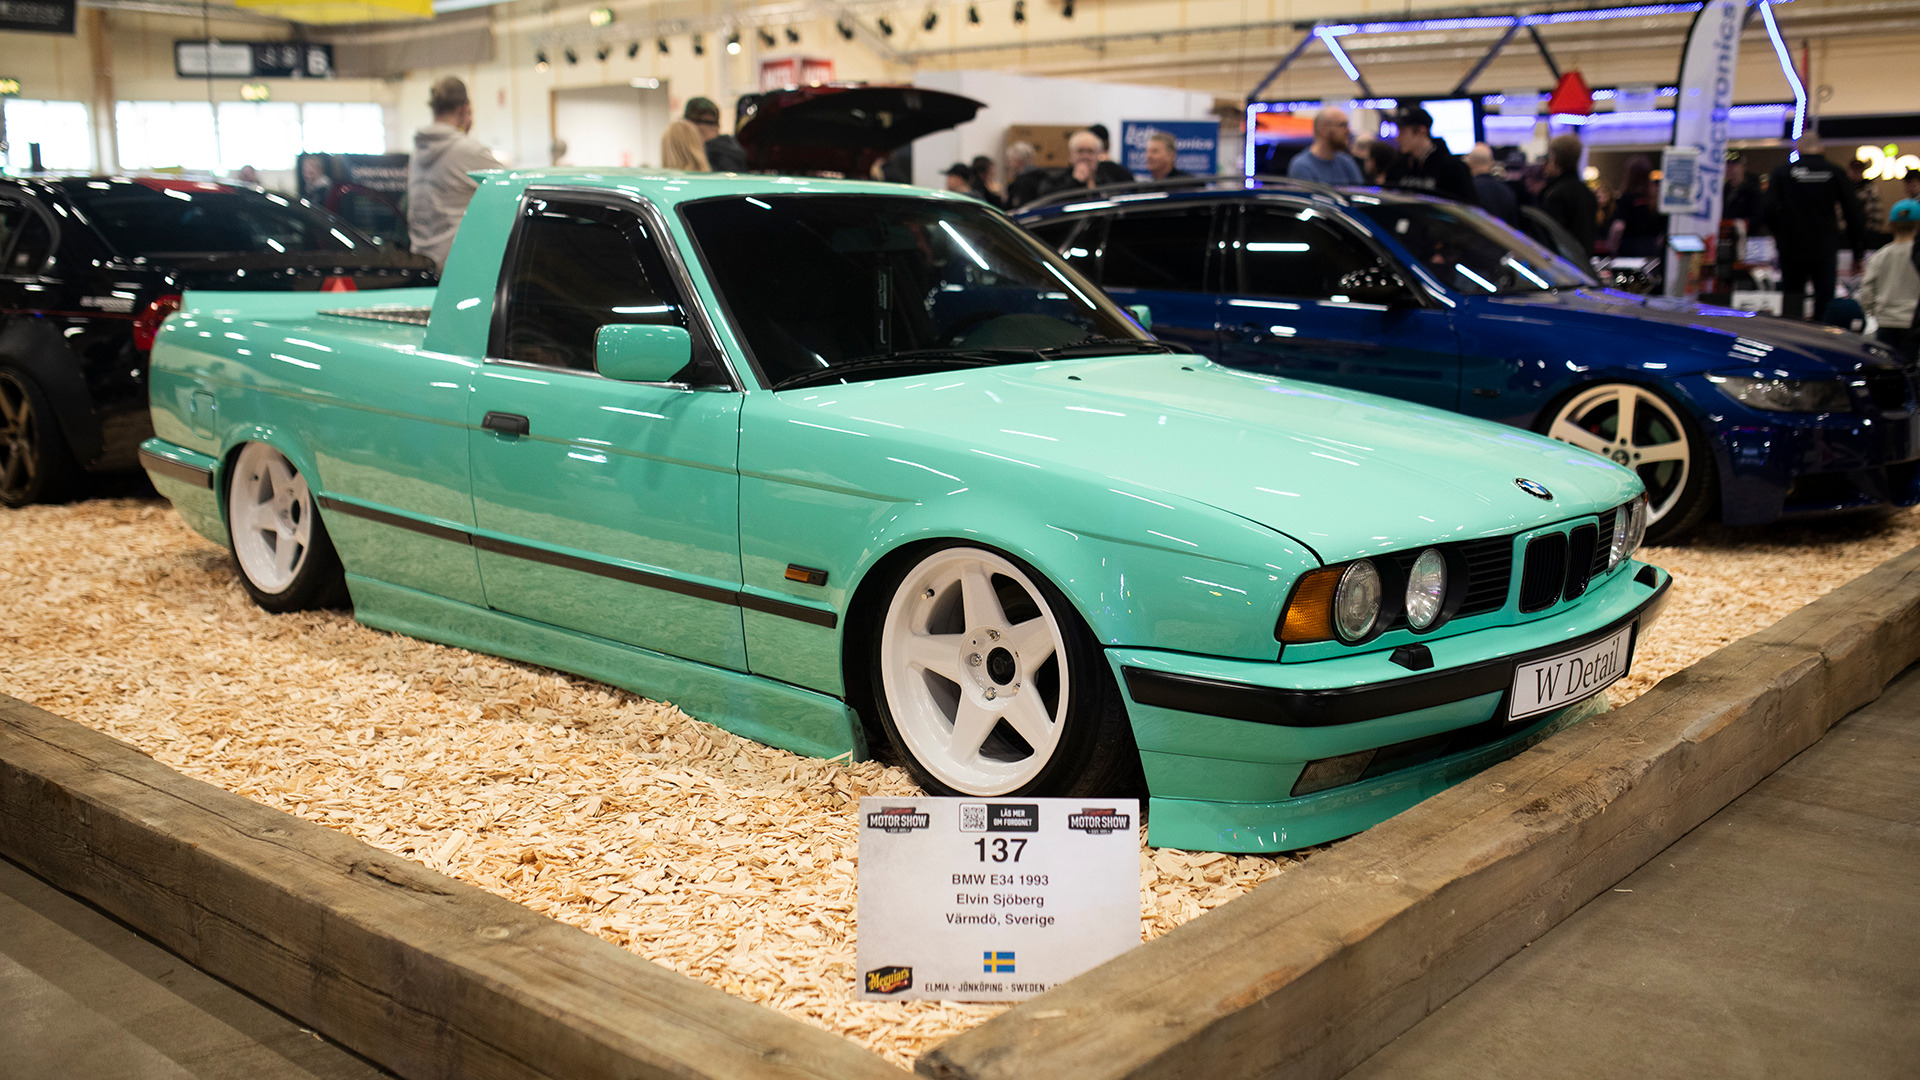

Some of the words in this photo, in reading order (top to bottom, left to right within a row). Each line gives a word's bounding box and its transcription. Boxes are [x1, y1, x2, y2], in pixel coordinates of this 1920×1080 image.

[1536, 663, 1563, 704] W
[1564, 636, 1620, 696] Detail
[1012, 809, 1026, 818] MER
[870, 814, 900, 828] MOTOR
[900, 814, 927, 828] SHOW
[1071, 815, 1100, 829] MOTOR
[1101, 815, 1127, 829] SHOW
[974, 837, 1028, 863] 137
[952, 873, 986, 886] BMW
[990, 874, 1014, 886] E34
[1019, 874, 1049, 886] 1993
[956, 893, 989, 905] Elvin
[993, 893, 1044, 909] Sjöberg
[945, 912, 1001, 927] Värmdö,
[1005, 913, 1055, 928] Sverige
[925, 983, 950, 993] ELMIA
[958, 981, 1003, 993] JÖNKÖPING
[1011, 983, 1046, 993] SWEDEN
